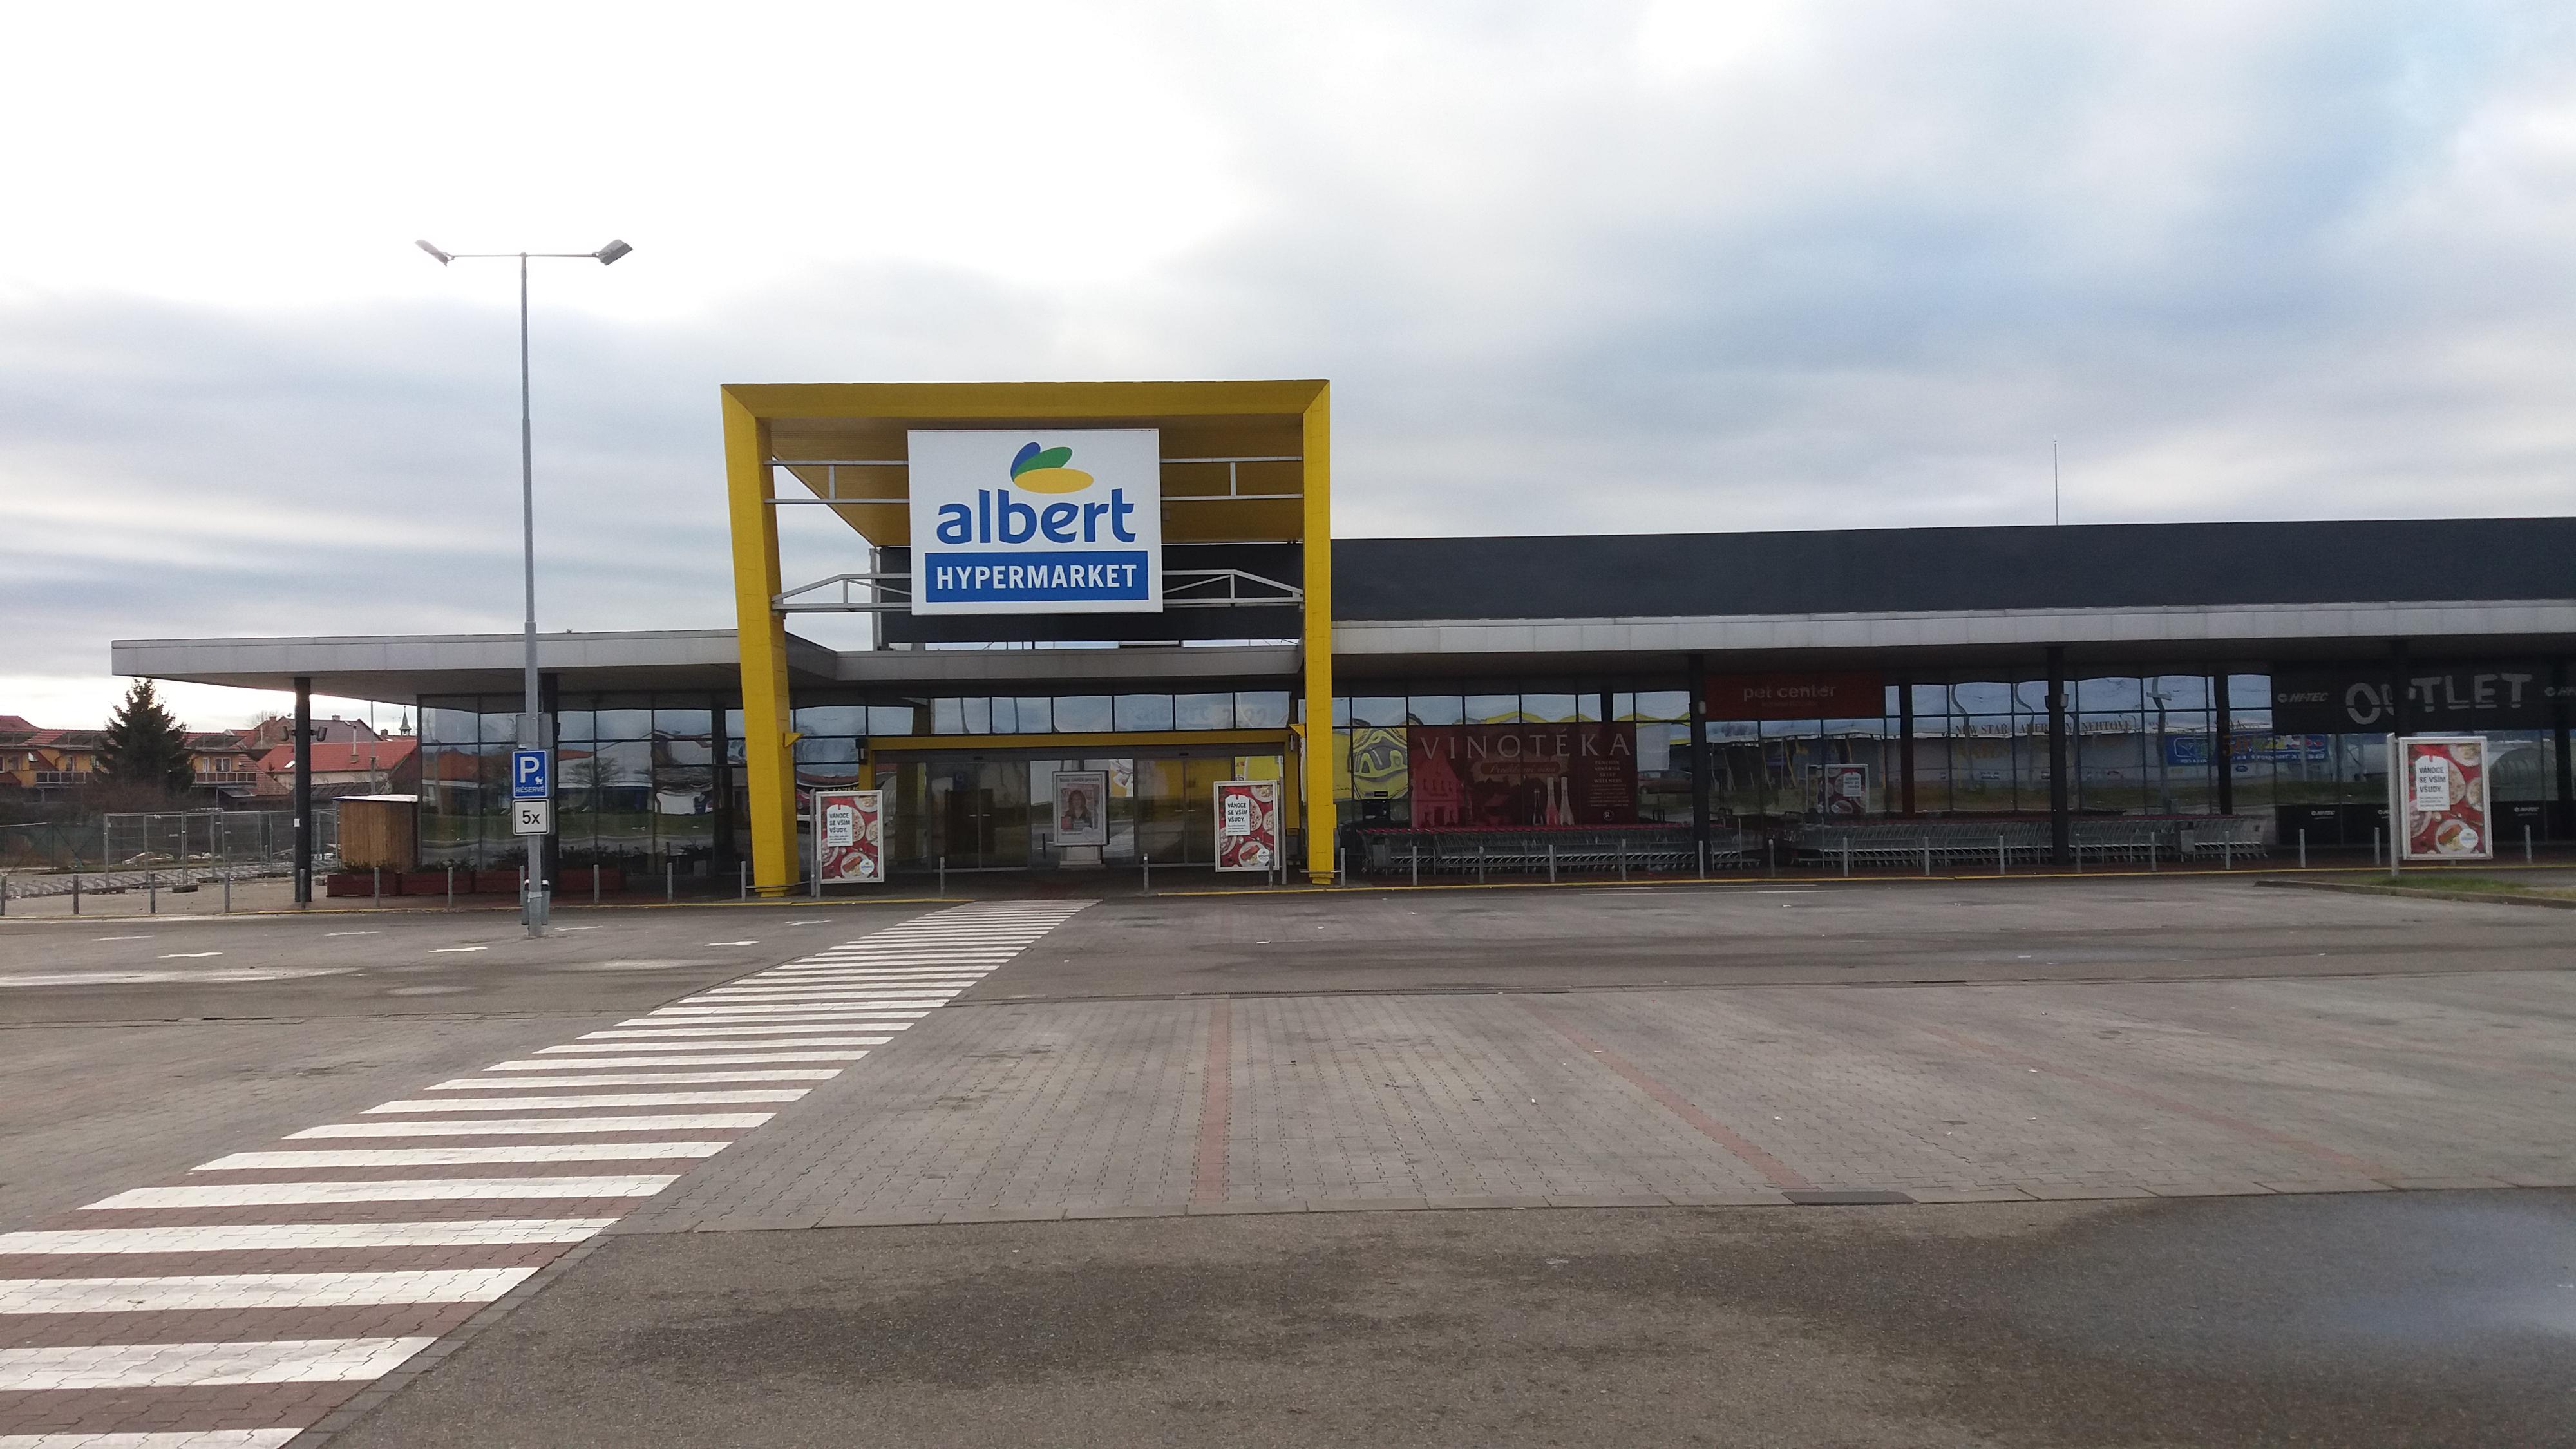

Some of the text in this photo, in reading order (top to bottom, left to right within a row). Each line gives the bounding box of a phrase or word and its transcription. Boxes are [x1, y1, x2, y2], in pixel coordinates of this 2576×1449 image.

[936, 488, 1136, 544] albert
[936, 564, 1137, 589] HYPERMARKET
[1743, 685, 1836, 701] pet center
[1956, 725, 1977, 734] NW
[1981, 723, 2008, 734] STAR
[1420, 728, 1631, 760] VINOTÉKA
[520, 757, 540, 783] P
[522, 810, 540, 824] 5x
